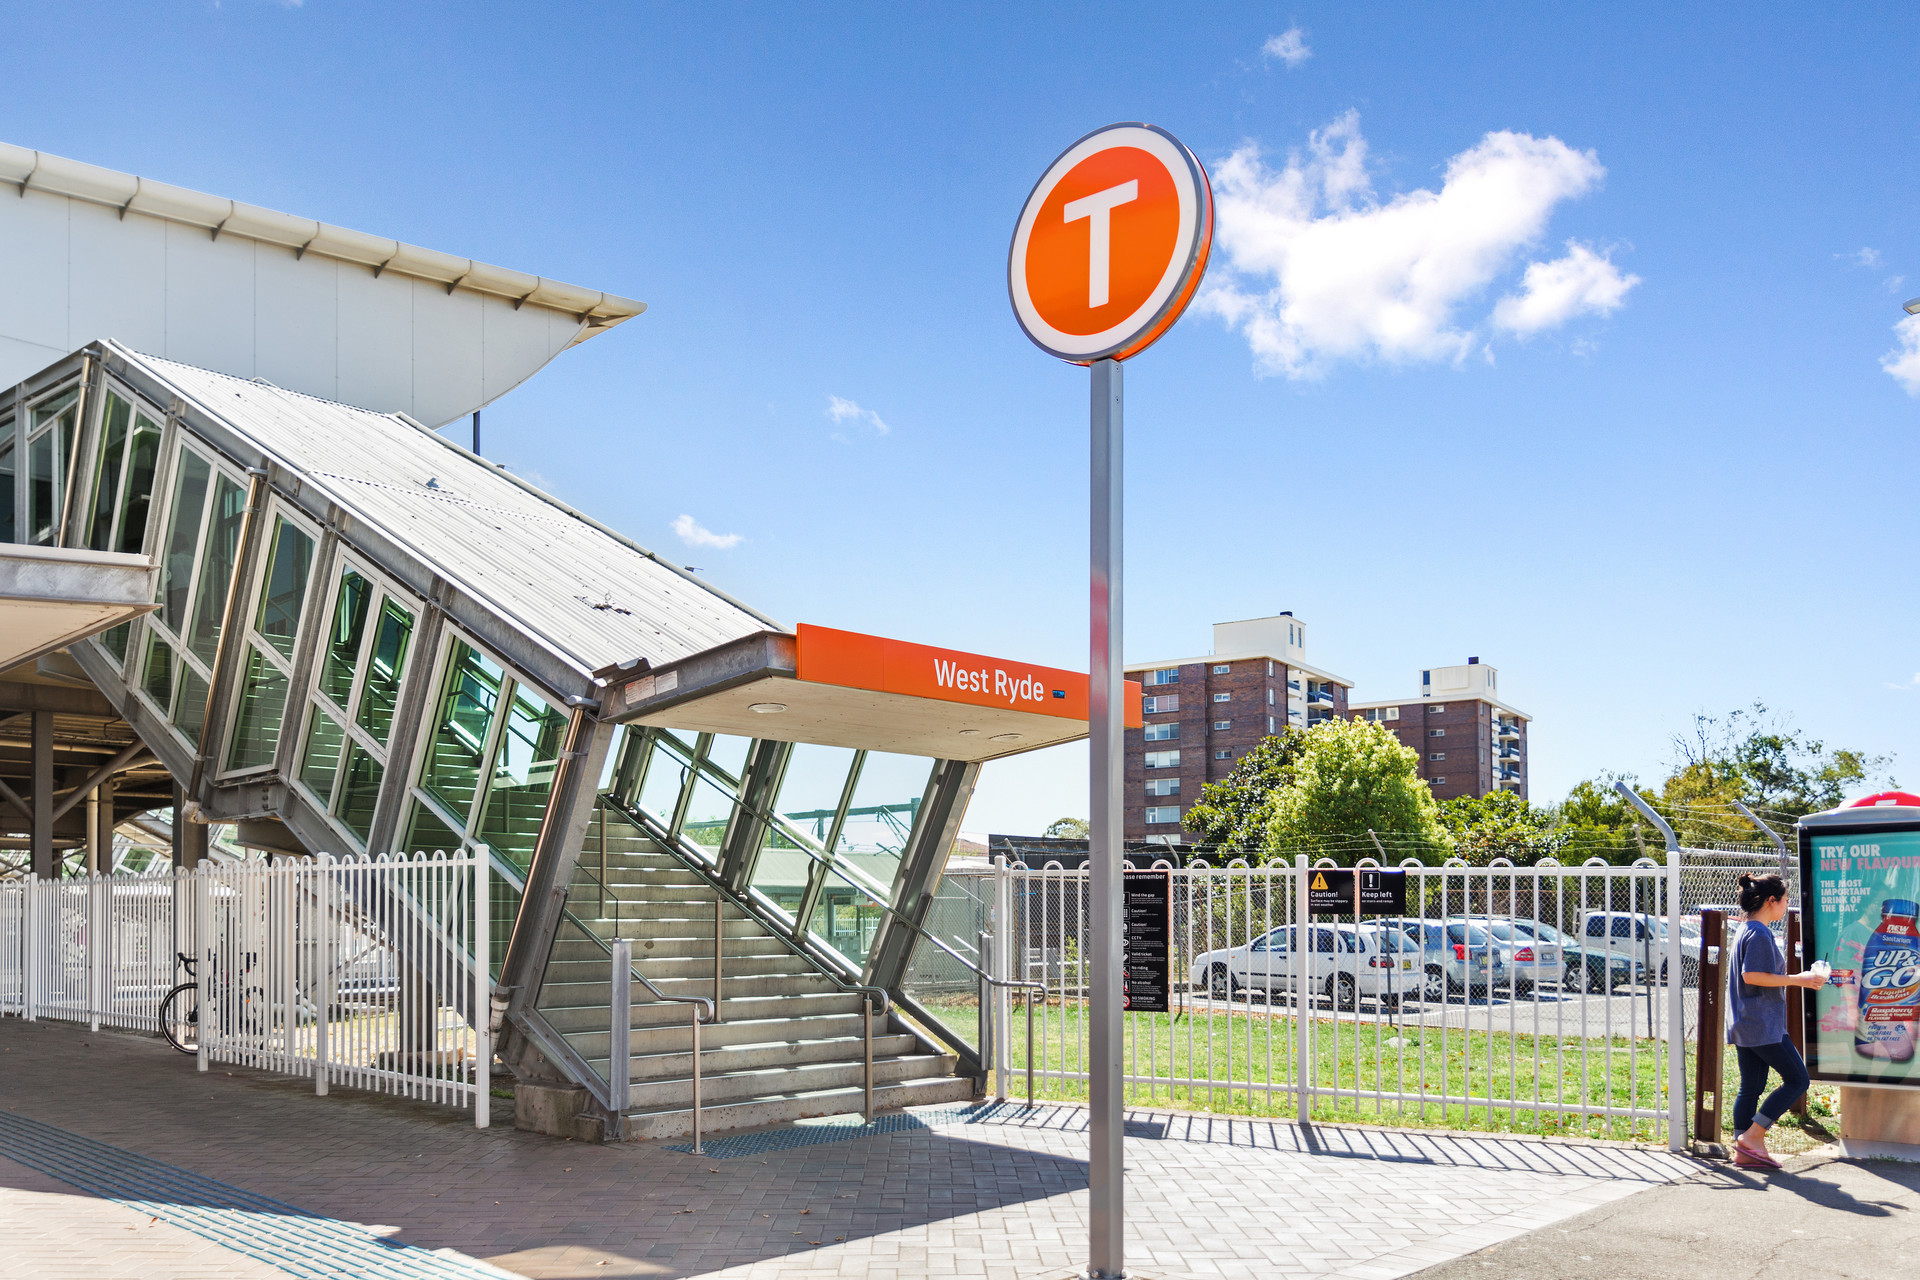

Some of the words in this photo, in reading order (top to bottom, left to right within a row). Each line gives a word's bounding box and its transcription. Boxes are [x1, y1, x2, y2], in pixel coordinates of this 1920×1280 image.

[1063, 178, 1138, 309] T
[934, 658, 989, 694] West
[995, 669, 1044, 704] Ryde
[1819, 845, 1845, 858] TRY
[1849, 844, 1880, 857] OUR
[1820, 858, 1852, 871] NEW
[1820, 880, 1835, 888] THE
[1838, 879, 1862, 888] MOST
[1361, 891, 1379, 899] Keep
[1821, 887, 1871, 896] IMPORTANT
[1821, 896, 1848, 904] DRINK
[1850, 896, 1862, 904] OF
[1821, 904, 1836, 912] THE
[1839, 903, 1858, 912] DAY.
[1861, 966, 1920, 989] GO
